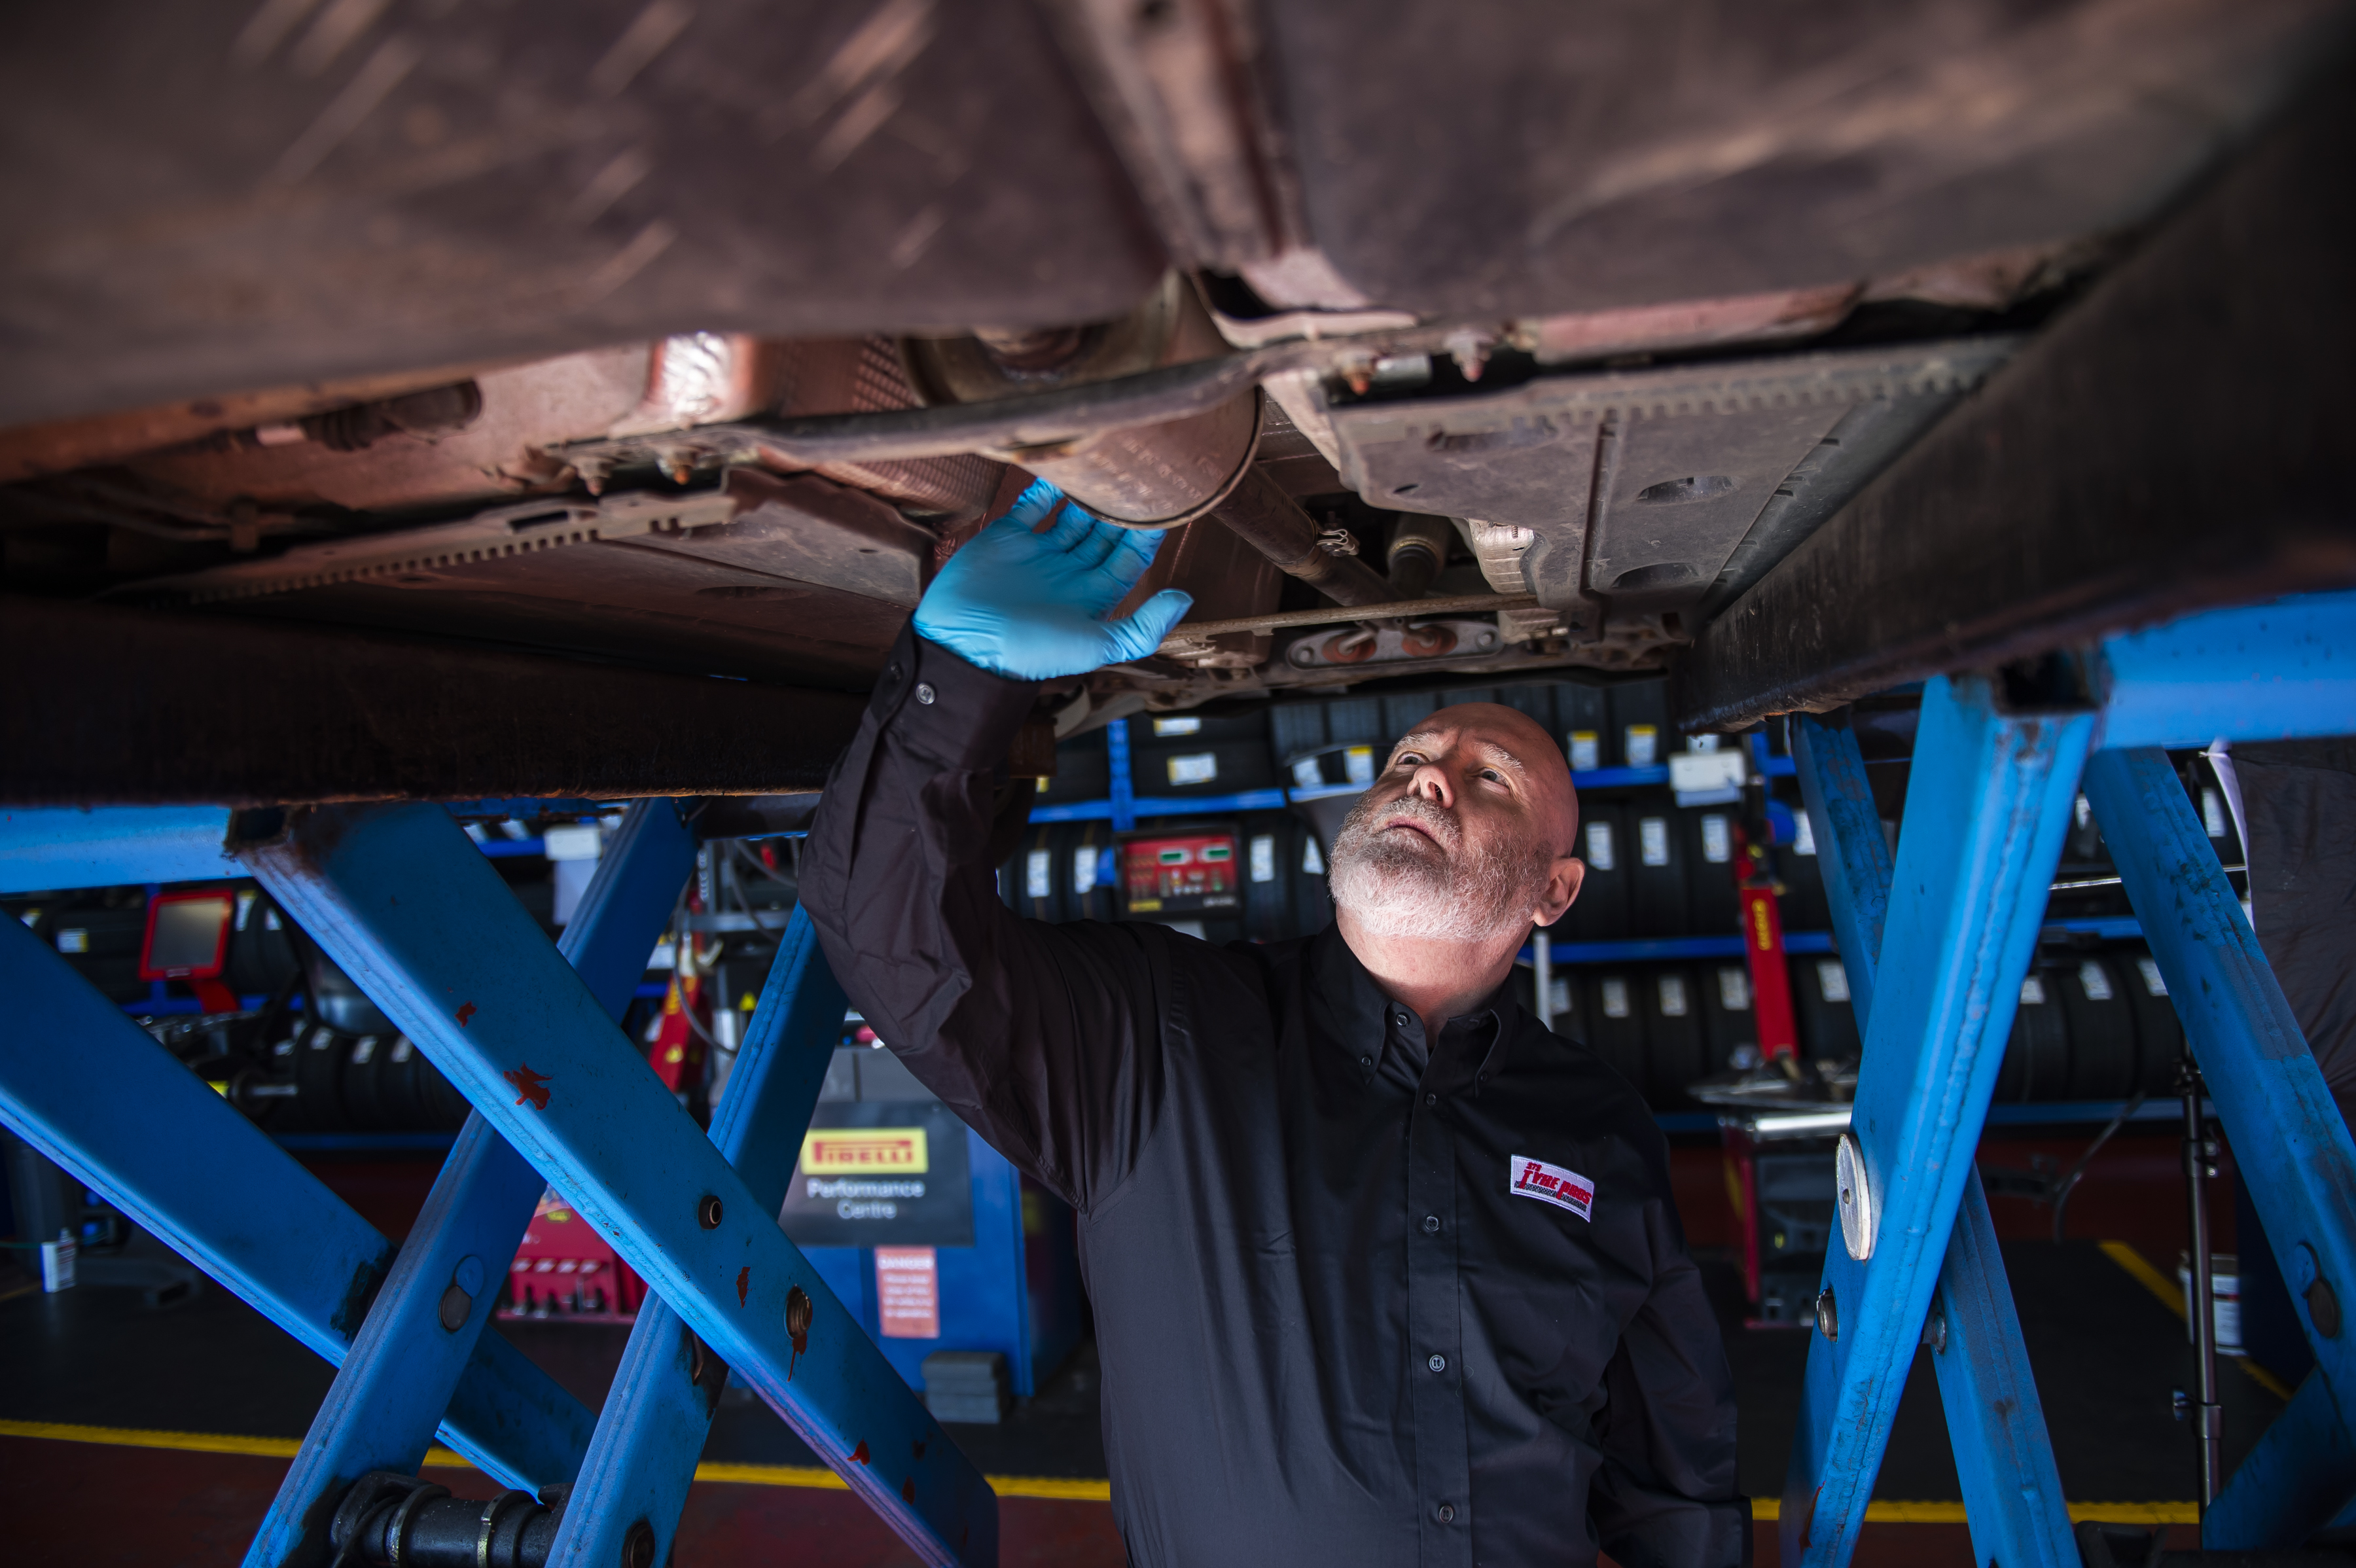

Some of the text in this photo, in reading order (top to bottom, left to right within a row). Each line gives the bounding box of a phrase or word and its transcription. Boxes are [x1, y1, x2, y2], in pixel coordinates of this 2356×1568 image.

[812, 1139, 913, 1164] PIRELLI
[807, 1178, 925, 1198] Performance
[1518, 1169, 1592, 1205] TYRE PROS
[837, 1198, 897, 1219] Centre
